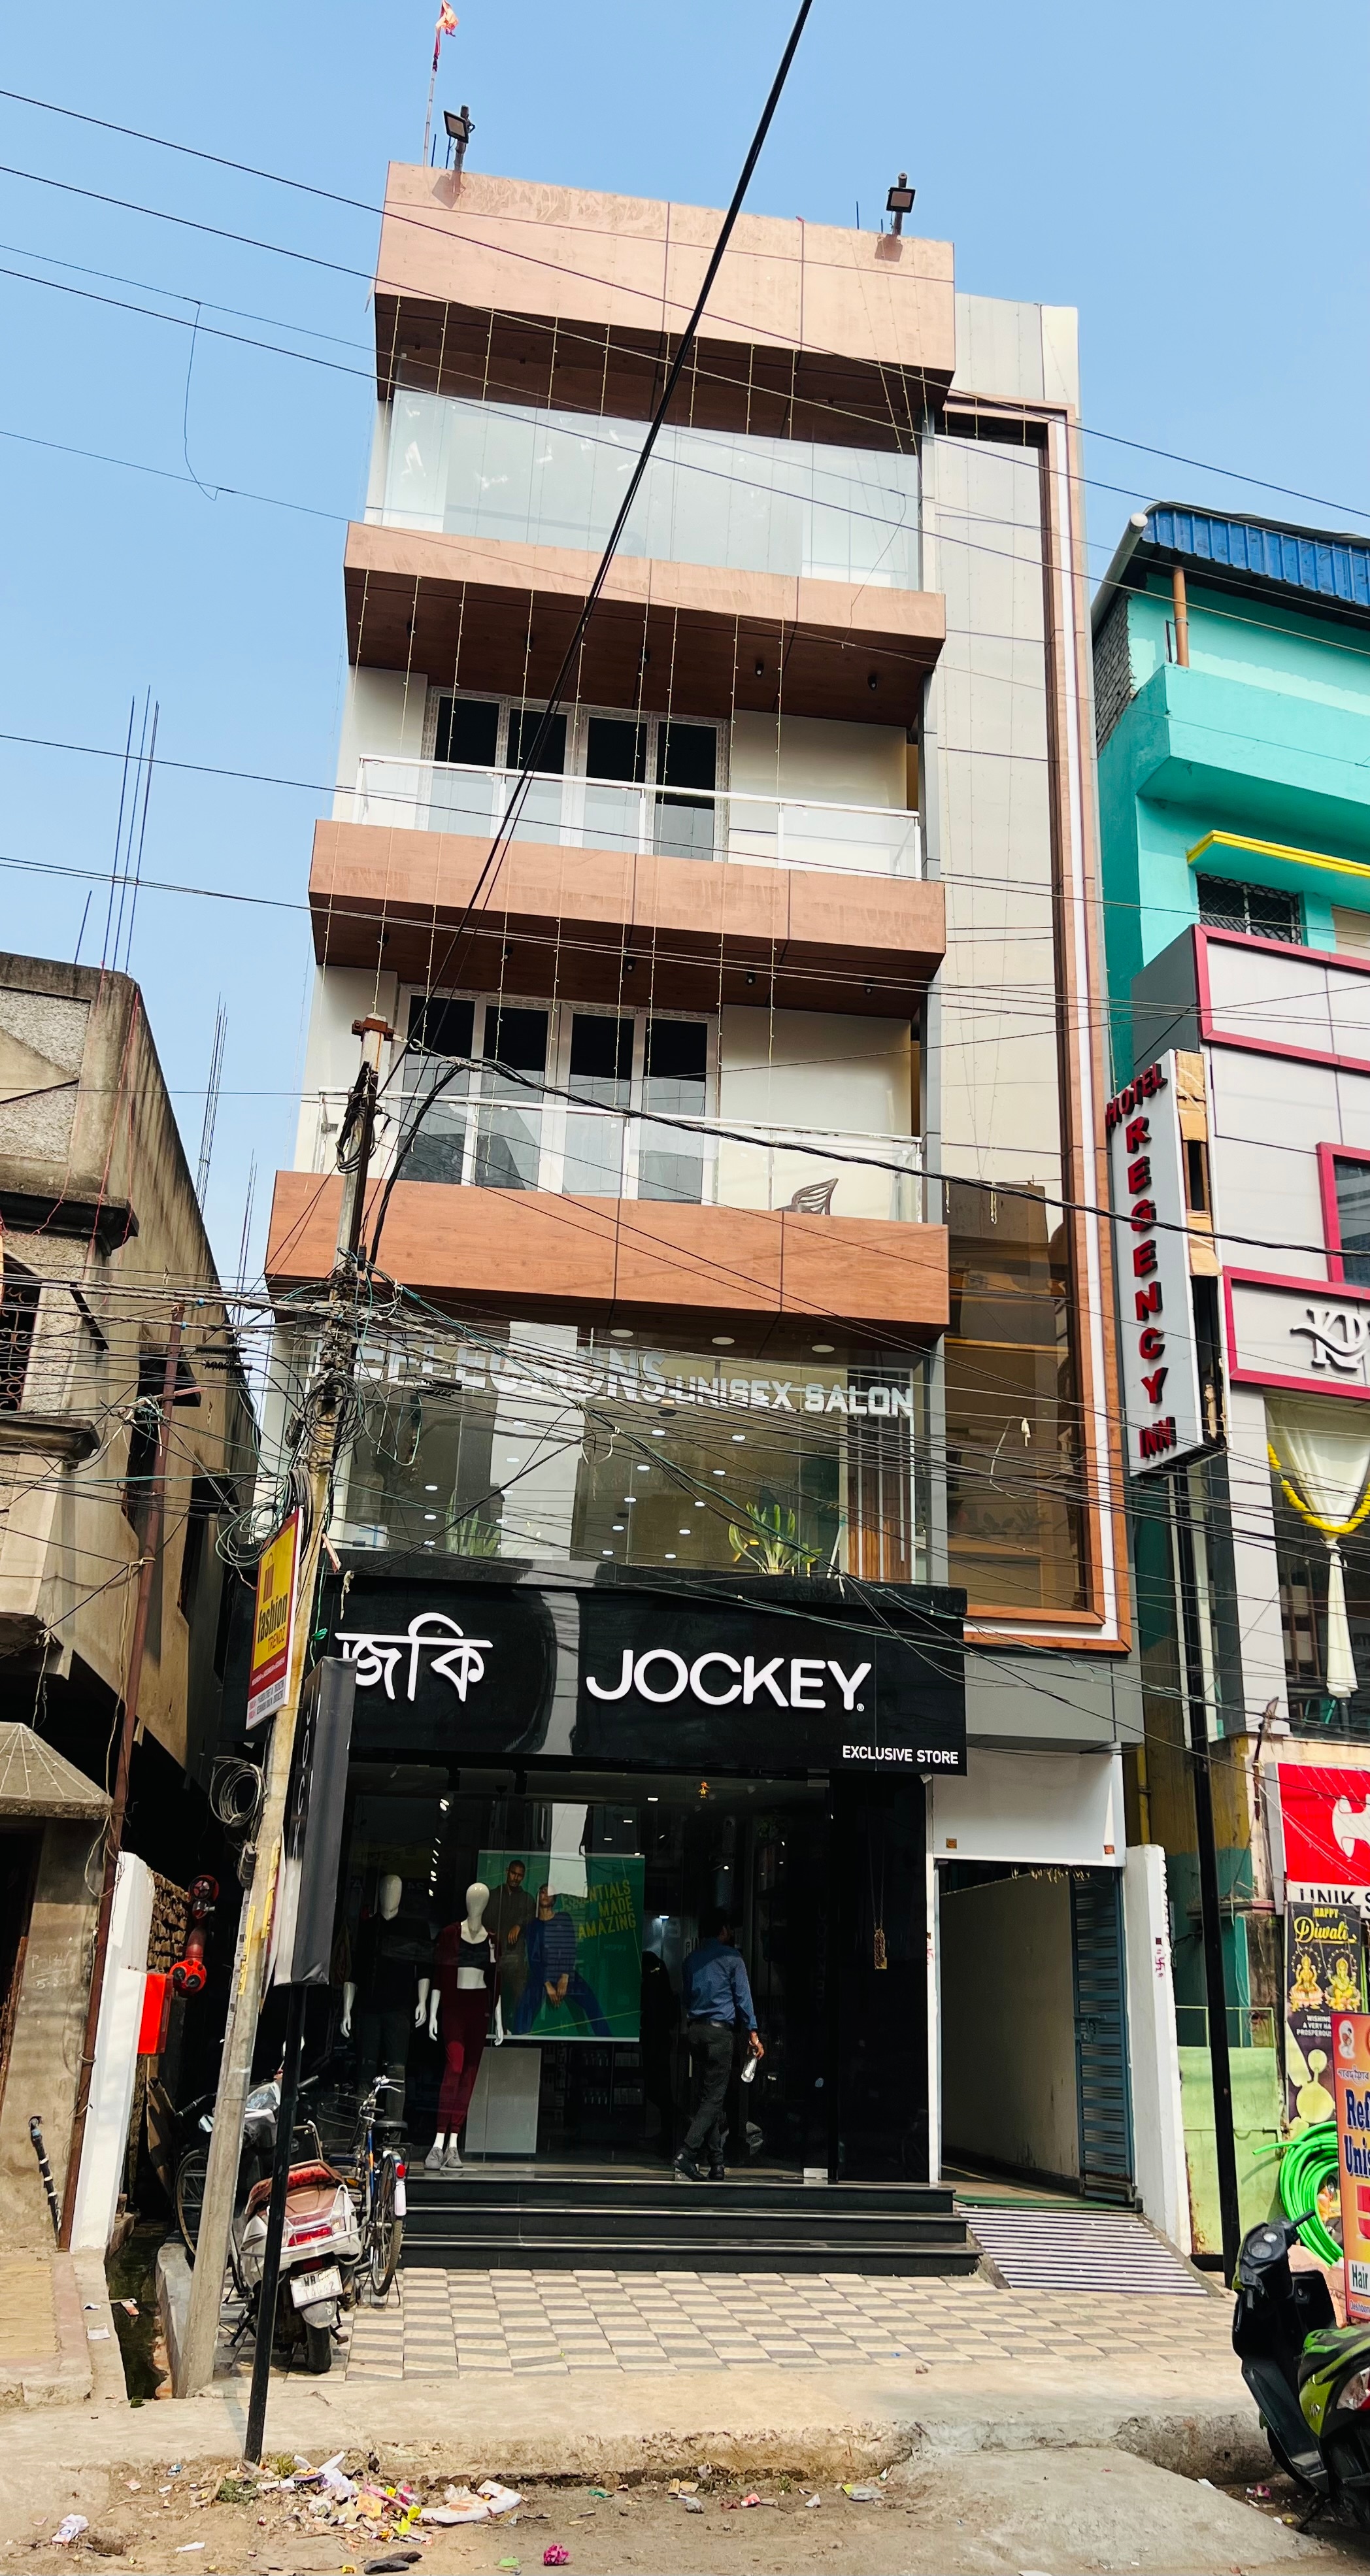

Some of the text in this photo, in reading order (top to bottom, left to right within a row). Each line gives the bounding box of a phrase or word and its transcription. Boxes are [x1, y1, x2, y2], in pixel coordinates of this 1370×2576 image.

[1105, 1063, 1168, 1128] HOTEL
[1126, 1116, 1169, 1403] REGENCY
[675, 1375, 794, 1412] UNISEX
[805, 1382, 913, 1418] SALON
[1139, 1416, 1177, 1458] INN
[258, 1593, 288, 1644] fashion
[586, 1648, 872, 1711] JOCKEY
[843, 1745, 959, 1765] EXCLUSIVE STORE
[598, 1895, 634, 1918] MADE
[1314, 1907, 1339, 1918] HAPPY
[578, 1912, 637, 1941] AMAZING
[1294, 1916, 1357, 1944] Diwali
[1352, 2264, 1369, 2290] Hair
